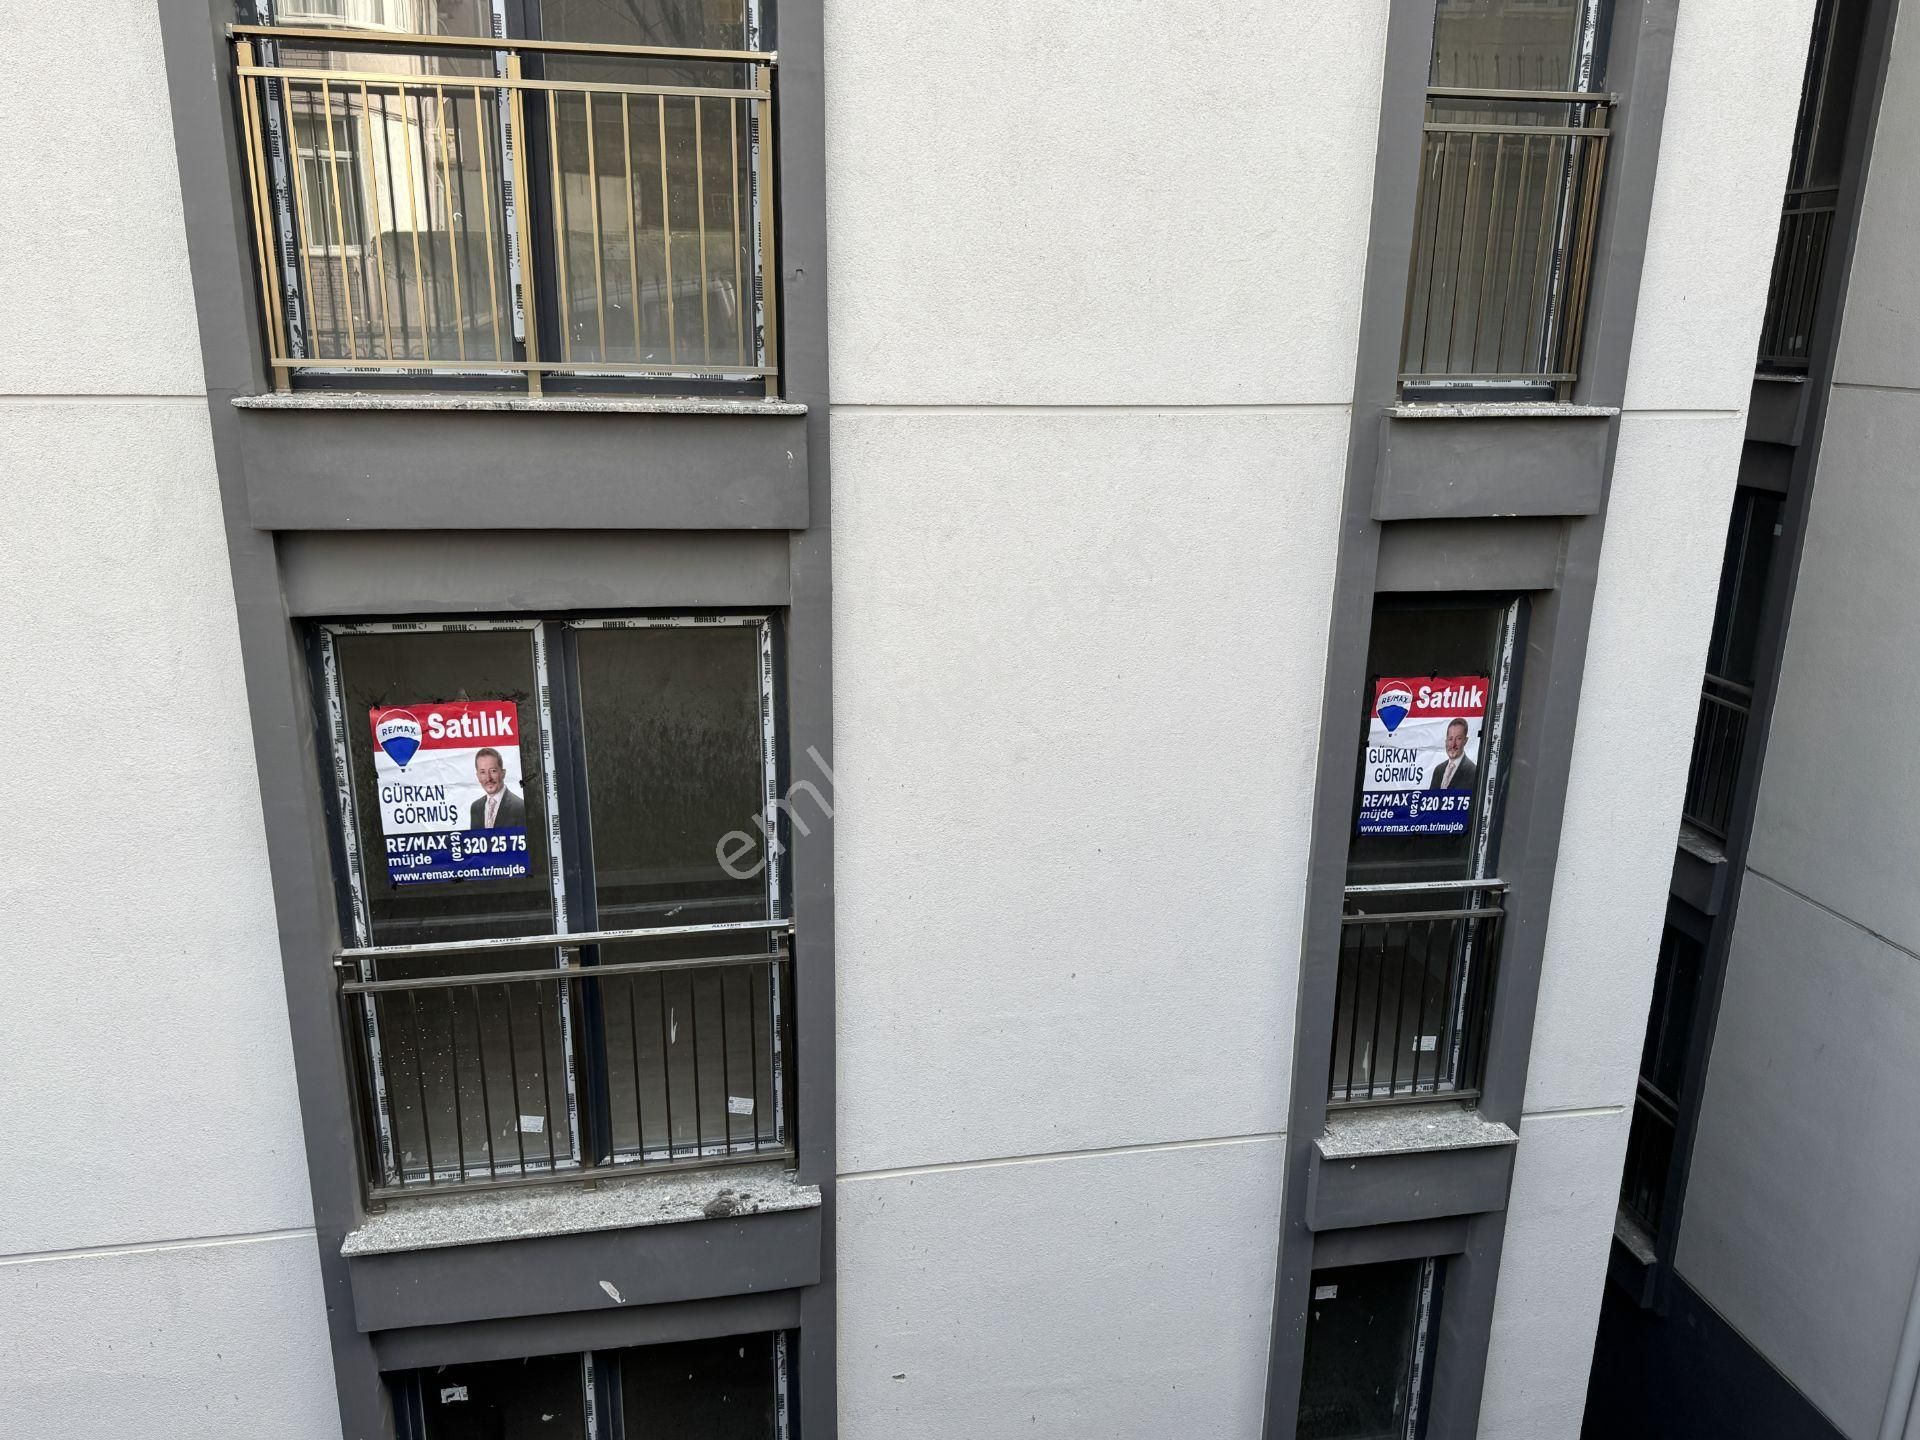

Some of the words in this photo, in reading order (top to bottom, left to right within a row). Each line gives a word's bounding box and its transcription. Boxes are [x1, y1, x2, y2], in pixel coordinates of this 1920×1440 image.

[1381, 696, 1409, 705] RE/MAX
[1417, 686, 1483, 709] Satılık
[381, 725, 417, 737] RE/MAX
[427, 710, 514, 739] Satılık
[1369, 745, 1418, 764] GÜRKAN
[1374, 764, 1424, 785] GÖRMÜŞ
[382, 782, 445, 803] GÜRKAN
[1362, 793, 1409, 808] RE/MAX
[1410, 790, 1422, 818] (0212)
[1420, 796, 1439, 811] 320
[1441, 796, 1455, 811] 25
[1457, 796, 1471, 810] 75
[394, 802, 458, 825] GÖRMÜŞ
[1359, 808, 1394, 821] müjde
[1360, 821, 1464, 833] www.remax.com.tr/mujde
[386, 835, 447, 853] RE/MAX
[450, 832, 462, 862] (0212)
[463, 837, 488, 854] 320
[491, 836, 507, 853] 25
[510, 835, 526, 852] 75
[388, 853, 432, 869] müjde
[393, 864, 525, 882] www.remax.com.tr/mujde
